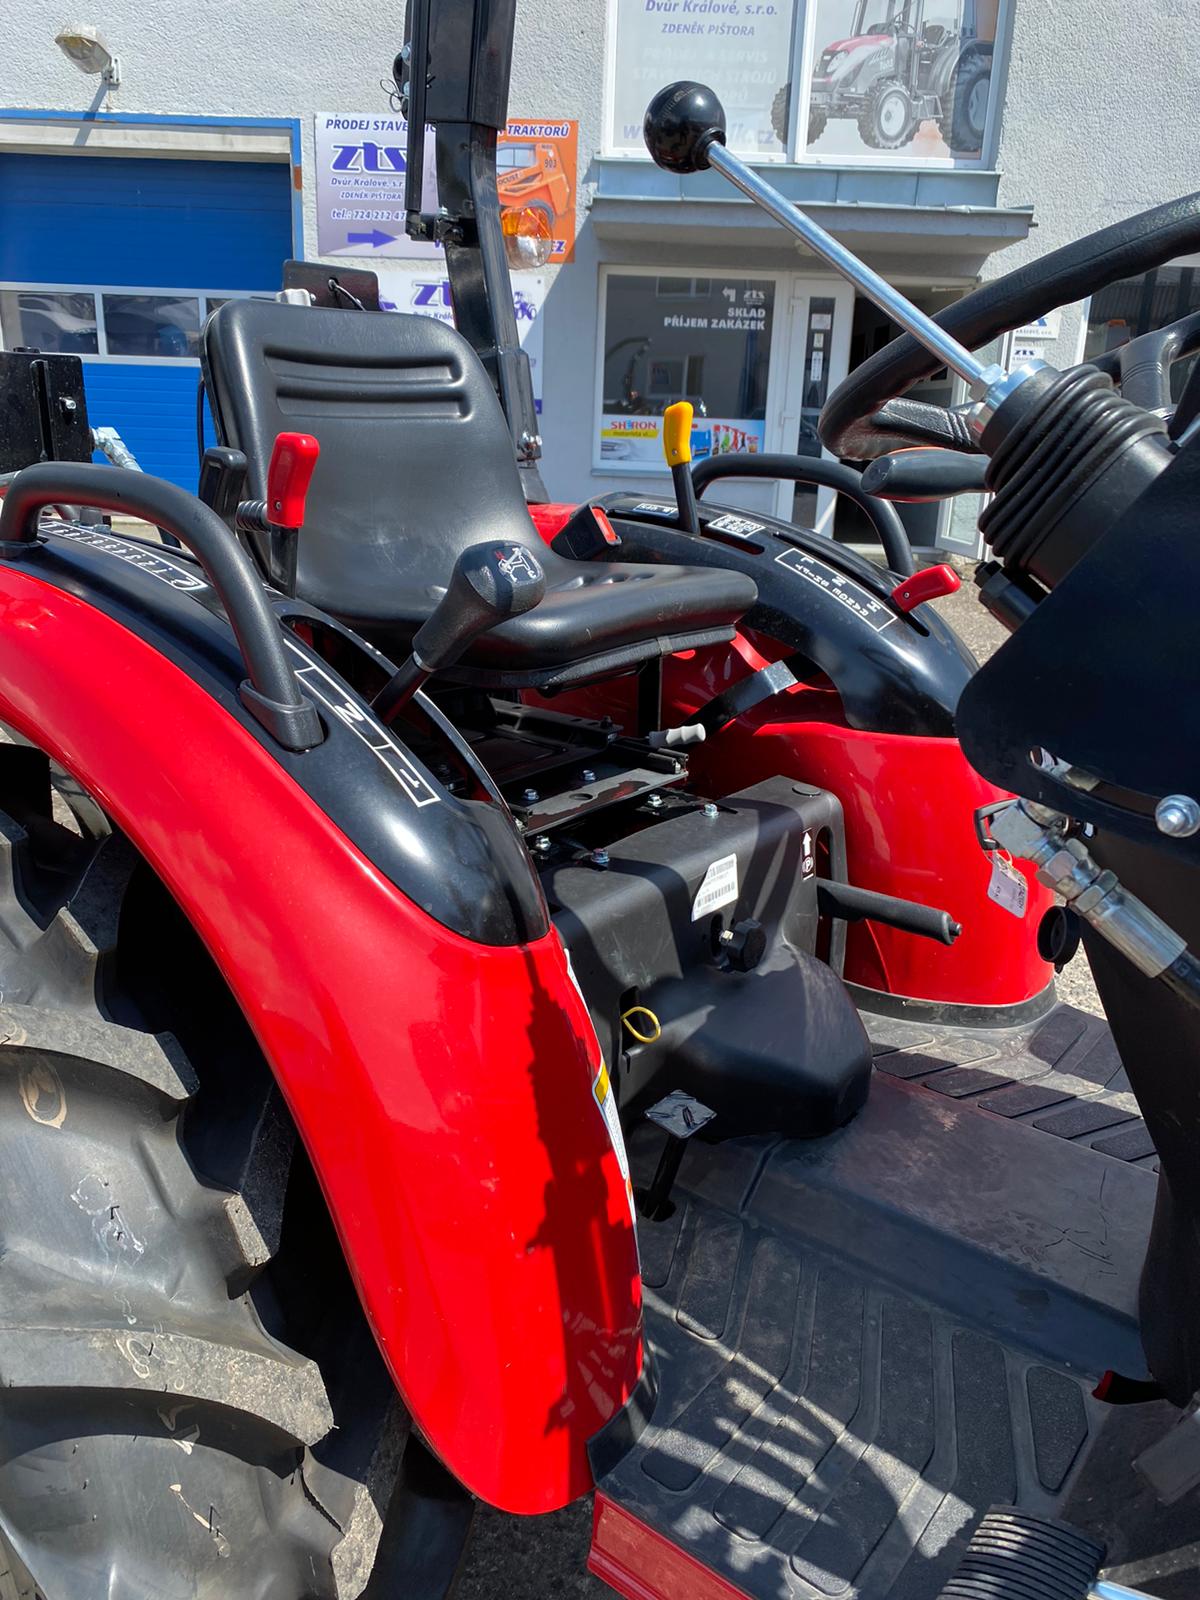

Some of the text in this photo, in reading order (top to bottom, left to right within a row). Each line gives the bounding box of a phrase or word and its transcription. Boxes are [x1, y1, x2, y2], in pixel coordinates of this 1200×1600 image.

[744, 4, 777, 15] s.r.o.
[661, 21, 755, 36] ZDENĚK PIŠTORA
[325, 119, 370, 130] PRODEJ
[508, 122, 569, 136] TRAKTORŮ
[332, 209, 406, 220] tel.: 724 212 47
[728, 307, 766, 318] SKLAD
[664, 315, 765, 330] PŘÍJEM ZAKÁZEK
[611, 419, 656, 430] SHERON
